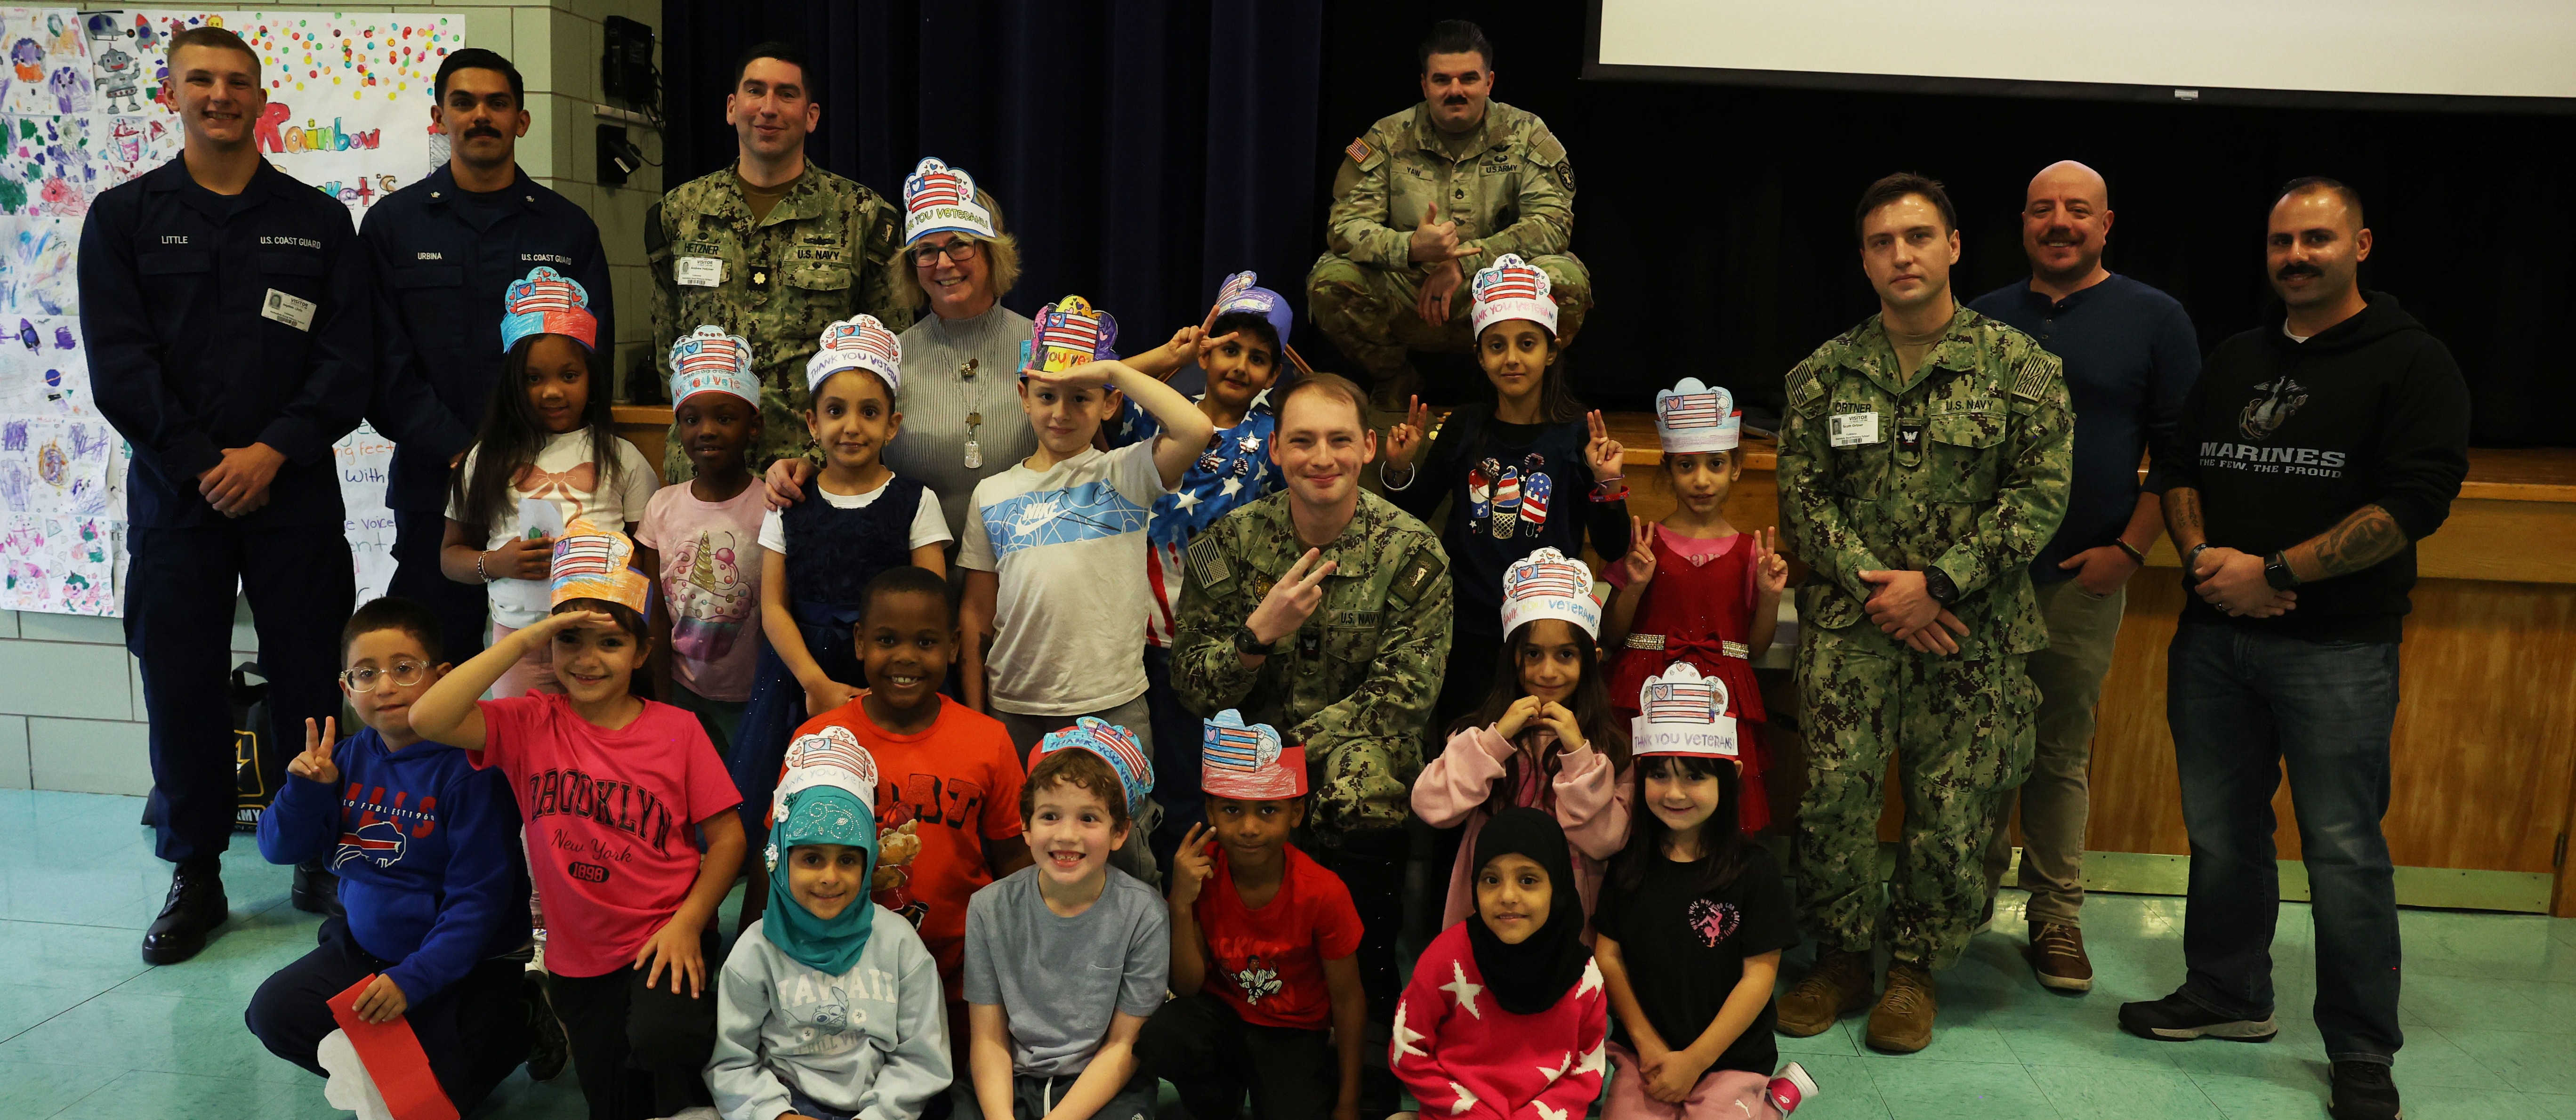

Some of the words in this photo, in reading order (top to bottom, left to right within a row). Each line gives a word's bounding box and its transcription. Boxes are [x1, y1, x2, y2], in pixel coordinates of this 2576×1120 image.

[254, 102, 380, 155] Rainbow
[1407, 167, 1421, 177] YAW
[915, 209, 933, 225] YOU
[161, 236, 188, 244] LITTLE
[274, 236, 297, 245] COAST
[299, 238, 321, 249] GUARD
[684, 242, 719, 255] HETZNER
[797, 250, 813, 258] U.S.
[815, 250, 840, 260] NAVY
[555, 255, 572, 265] GUARD
[291, 298, 308, 307] VISITOR
[1489, 301, 1512, 314] YOU
[811, 355, 837, 378] THANK
[1835, 402, 1872, 413] ORTNER
[1946, 400, 1964, 410] U.S.
[1967, 400, 1993, 410] NAVY
[2200, 442, 2345, 467] MARINES
[2219, 460, 2248, 471] FEW.
[2254, 464, 2279, 473] THE
[346, 467, 385, 483] With
[1022, 499, 1059, 521] NIKE
[1521, 598, 1545, 613] YOU
[1341, 612, 1354, 624] U.S.
[1358, 613, 1381, 625] NAVY
[1050, 738, 1093, 748] THANK
[1634, 734, 1652, 749] THANK
[1655, 733, 1680, 745] YOU
[810, 769, 836, 777] YOU
[361, 802, 387, 814] FTBL
[551, 828, 586, 852] New
[591, 838, 632, 862] York
[573, 863, 604, 882] 1898
